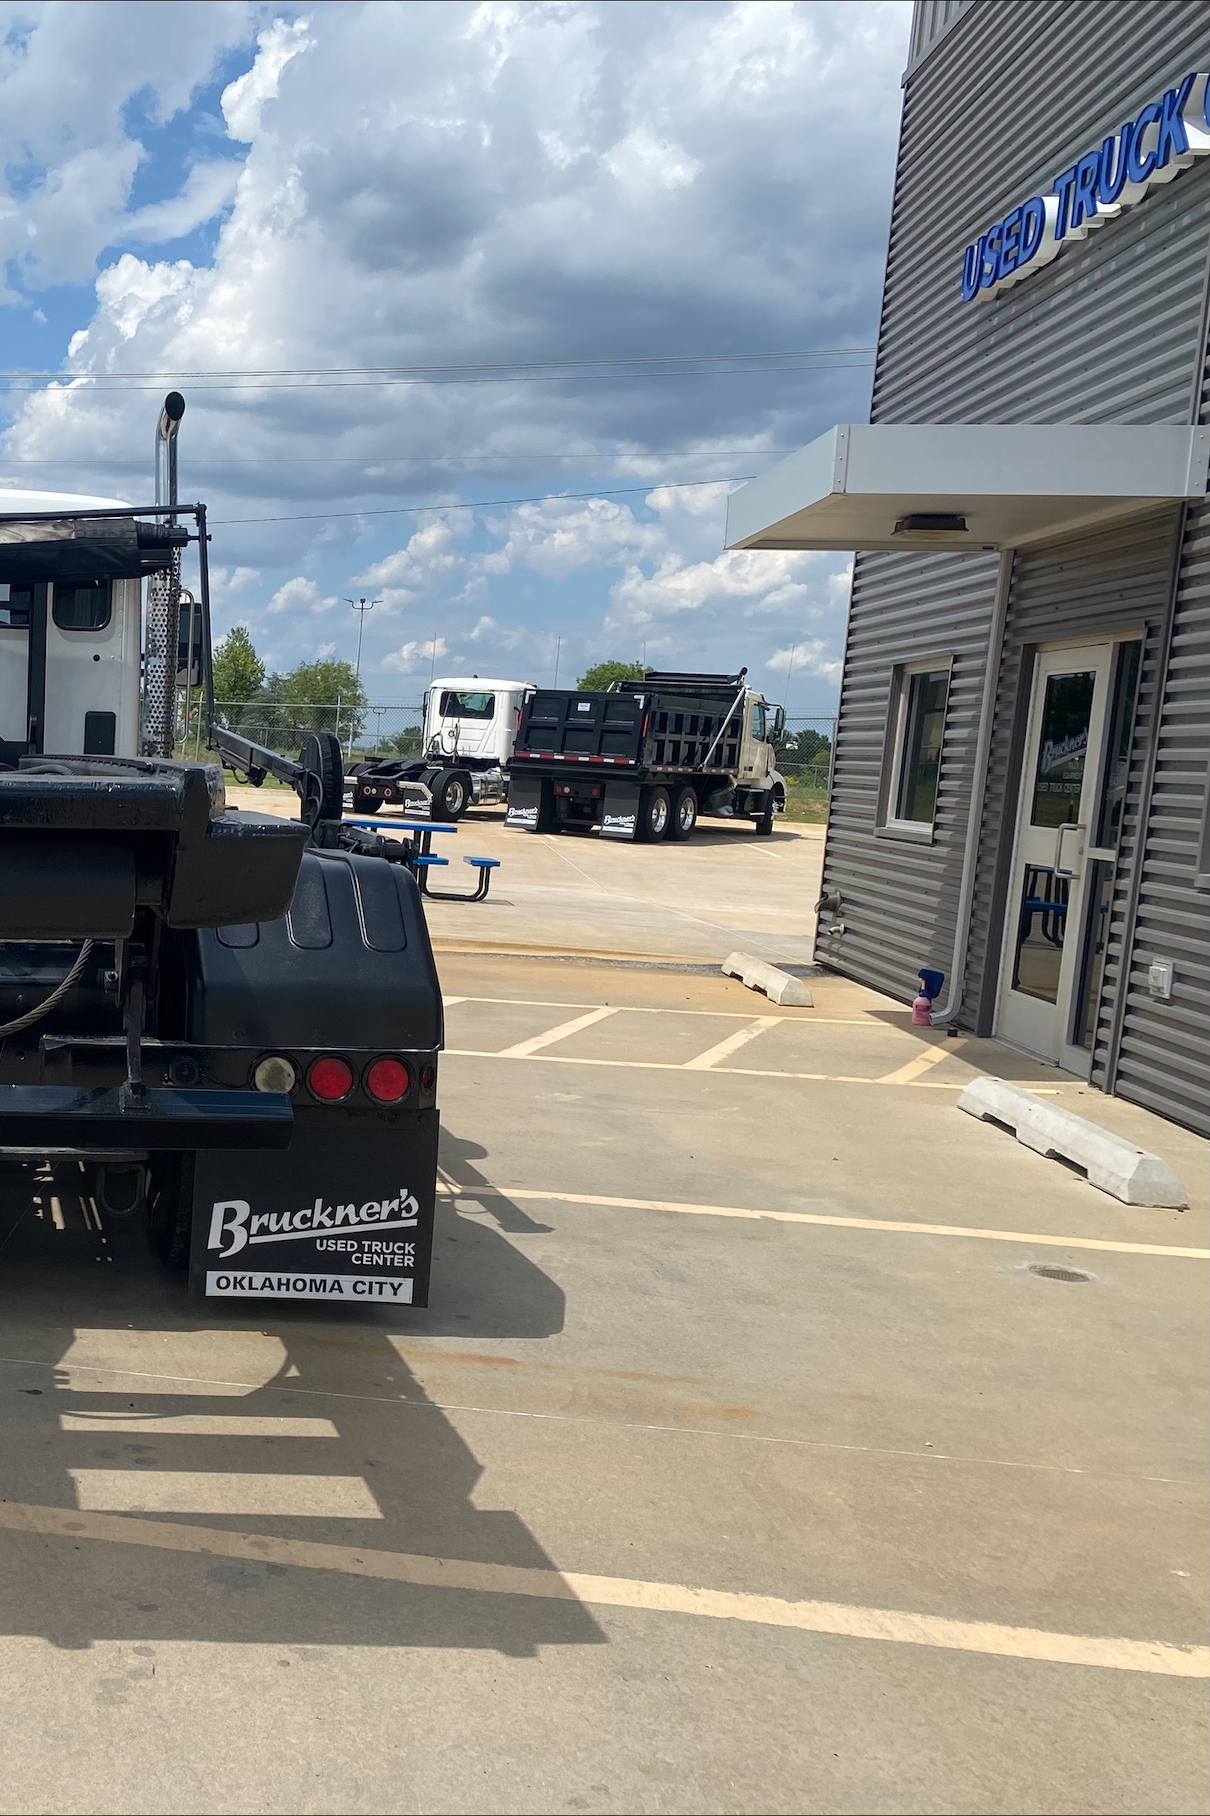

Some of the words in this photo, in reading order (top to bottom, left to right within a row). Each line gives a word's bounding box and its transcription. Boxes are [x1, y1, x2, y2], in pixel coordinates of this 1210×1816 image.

[961, 196, 1046, 301] USED
[1054, 73, 1197, 241] TRUCK
[206, 1188, 420, 1258] Bruckner's
[316, 1239, 359, 1252] USED
[361, 1240, 416, 1255] TRUCK
[351, 1253, 415, 1267] CENTER
[215, 1276, 344, 1294] OKLAHOMA
[352, 1280, 404, 1296] CITY
